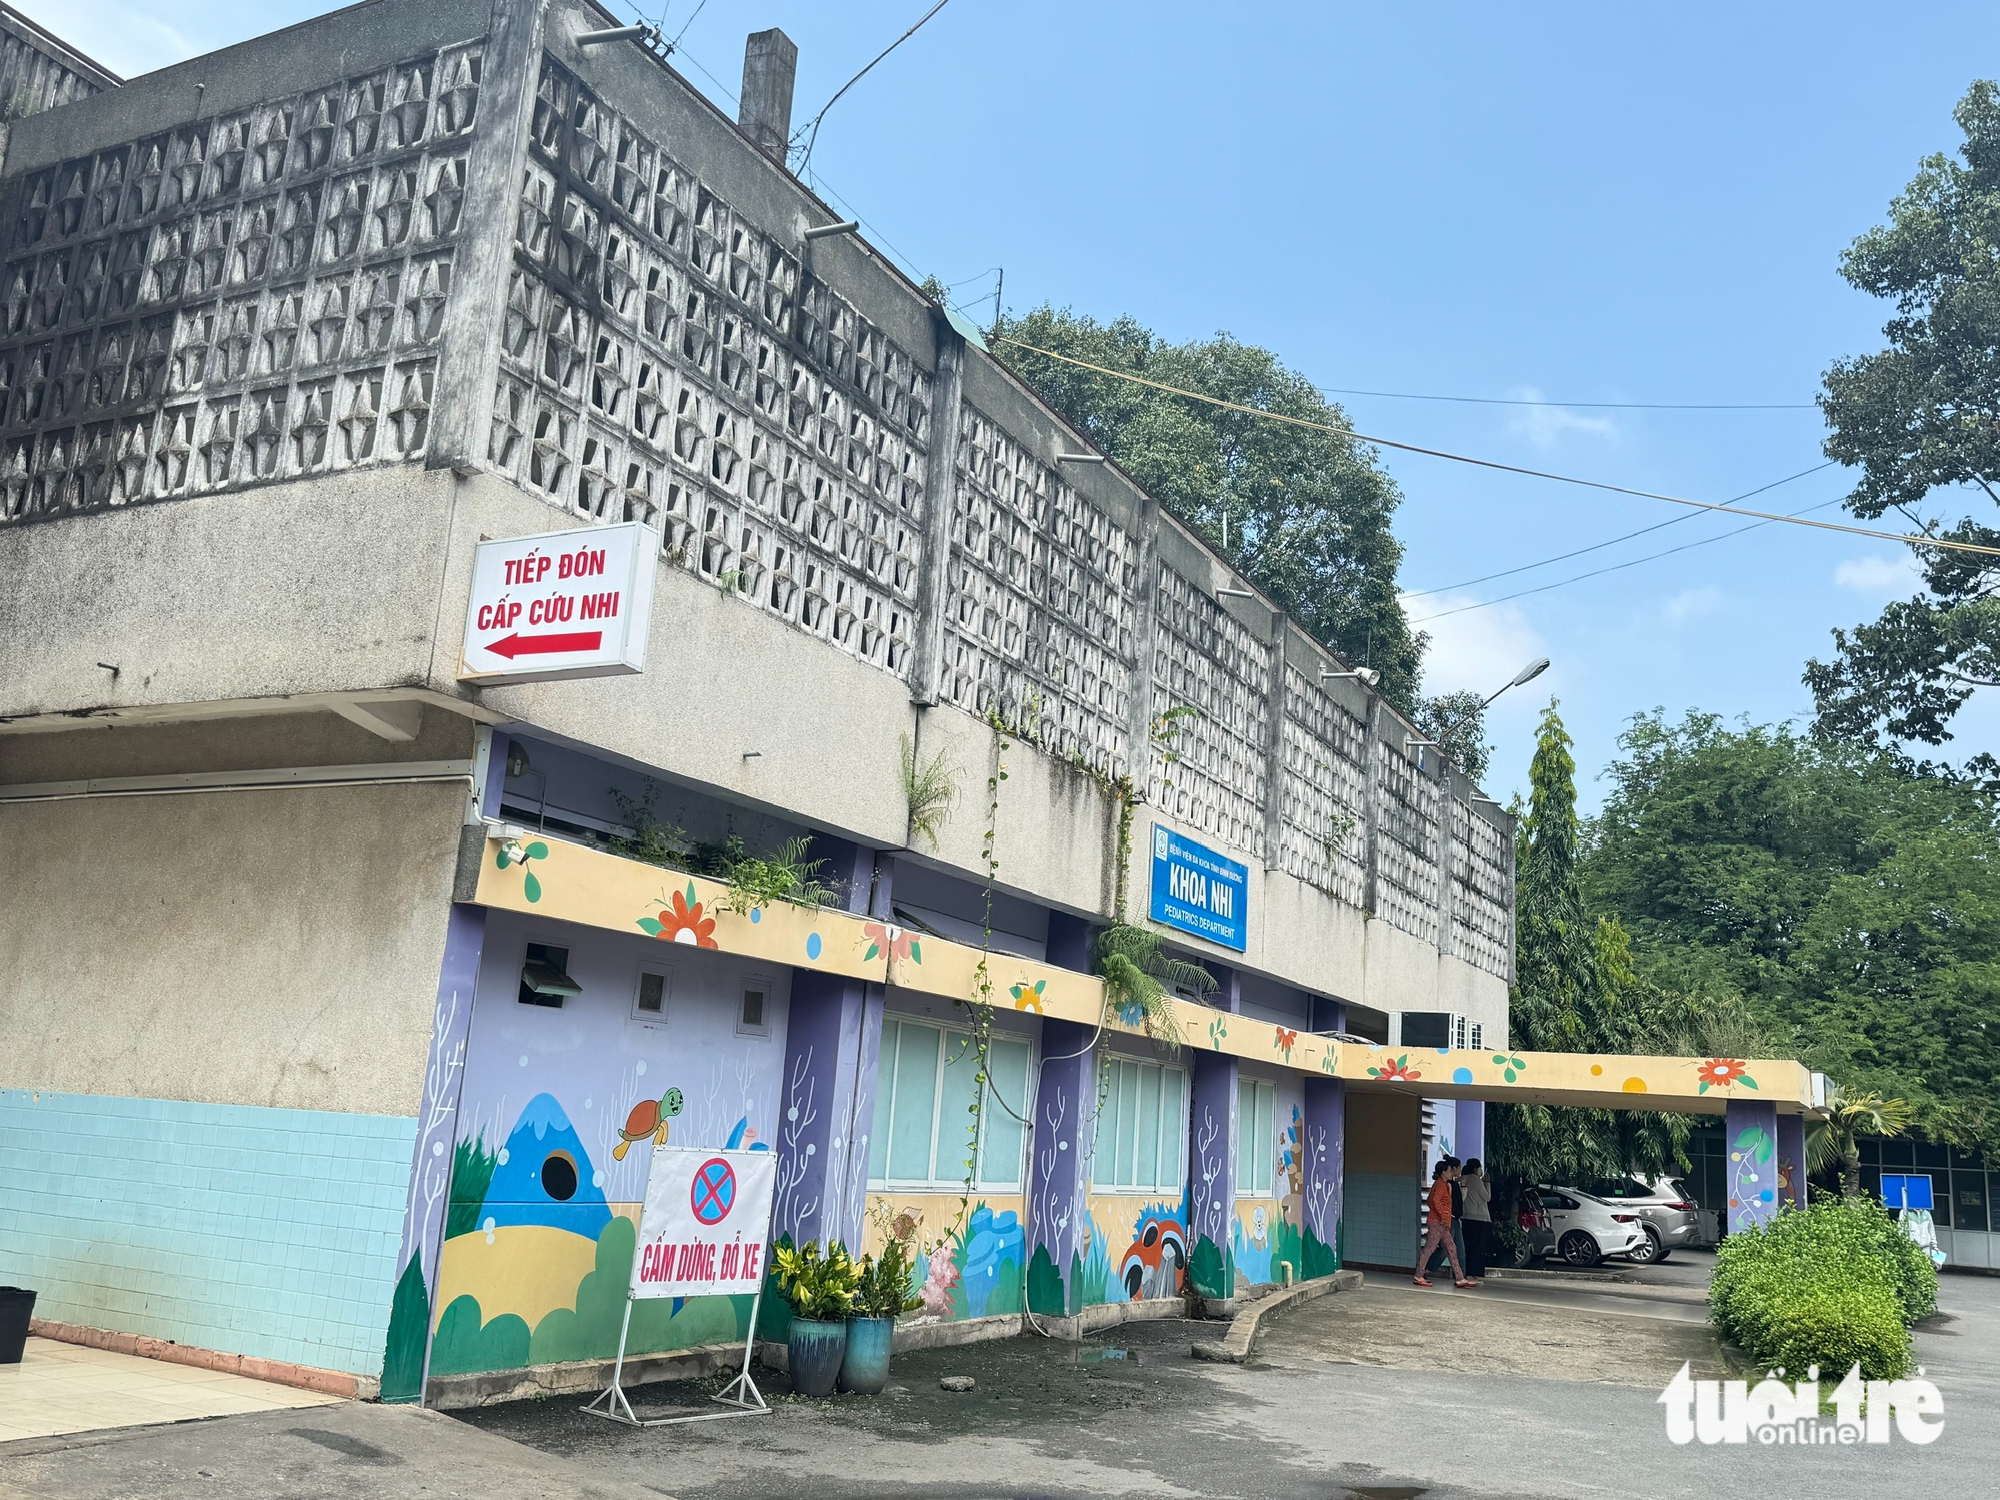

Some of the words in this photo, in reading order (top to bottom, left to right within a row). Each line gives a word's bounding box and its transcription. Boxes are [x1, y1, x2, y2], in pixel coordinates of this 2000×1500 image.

[505, 547, 551, 586] TIẾP
[558, 545, 606, 579] ĐÓN
[477, 593, 522, 631] CẤP
[529, 591, 574, 625] CỨU
[580, 591, 620, 620] NHI
[1169, 862, 1207, 909] KHOA
[1210, 880, 1233, 919] NHI
[1164, 904, 1199, 926] PEDIATRICS
[1199, 920, 1235, 940] DEPARTMENT
[640, 1230, 677, 1283] CẤM
[676, 1236, 716, 1285] DỪNG,
[720, 1230, 742, 1281] ĐỖ
[741, 1243, 761, 1280] XE
